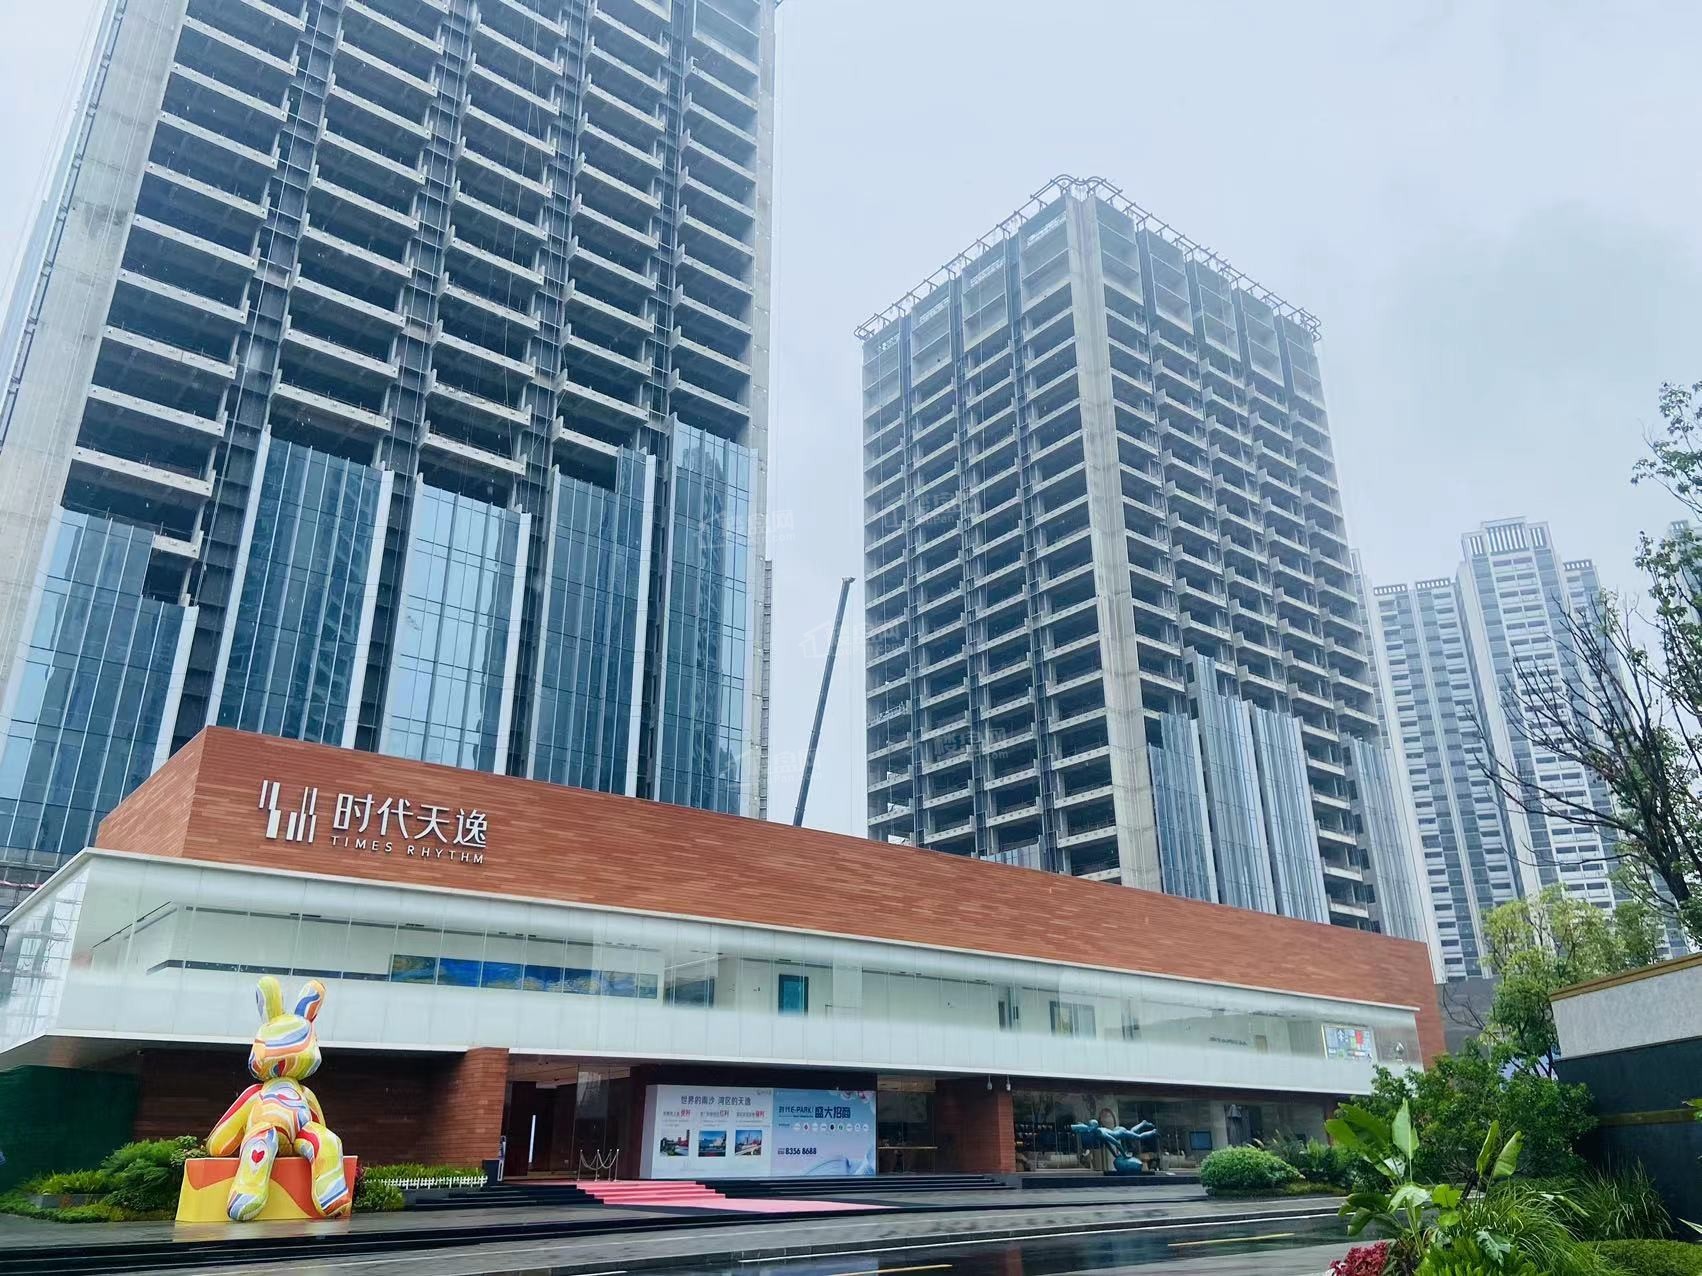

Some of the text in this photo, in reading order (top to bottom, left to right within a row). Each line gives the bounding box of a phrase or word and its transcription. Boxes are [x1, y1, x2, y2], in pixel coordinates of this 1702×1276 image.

[333, 793, 488, 849] 时代天逸
[331, 835, 484, 864] TIMES RHYTHM
